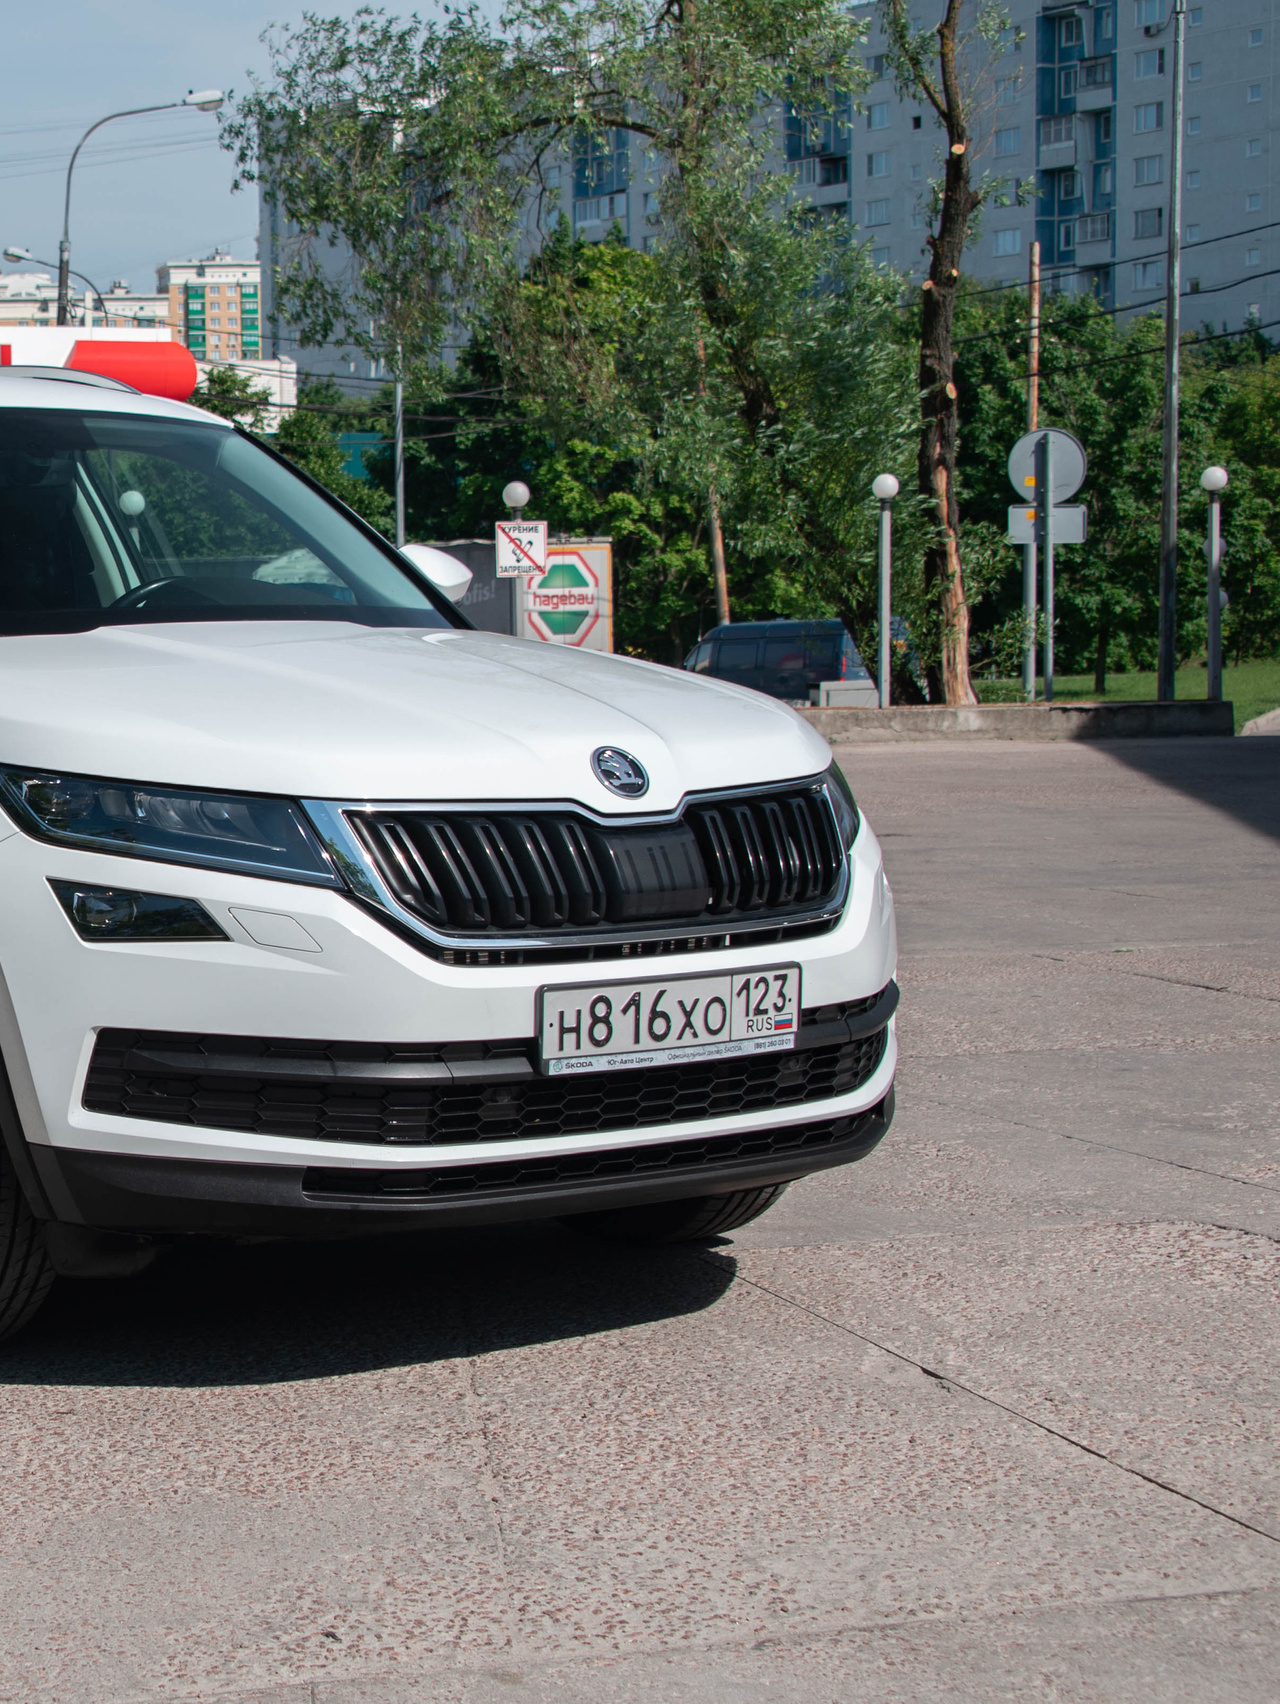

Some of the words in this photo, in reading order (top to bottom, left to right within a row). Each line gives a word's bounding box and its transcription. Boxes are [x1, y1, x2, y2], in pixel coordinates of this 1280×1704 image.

[502, 525, 540, 534] КУРЕНИЕ
[463, 580, 495, 605] ofis!
[532, 592, 594, 609] hagebau
[736, 973, 789, 1018] 123
[746, 1017, 774, 1033] RUS
[635, 1056, 654, 1064] Центр
